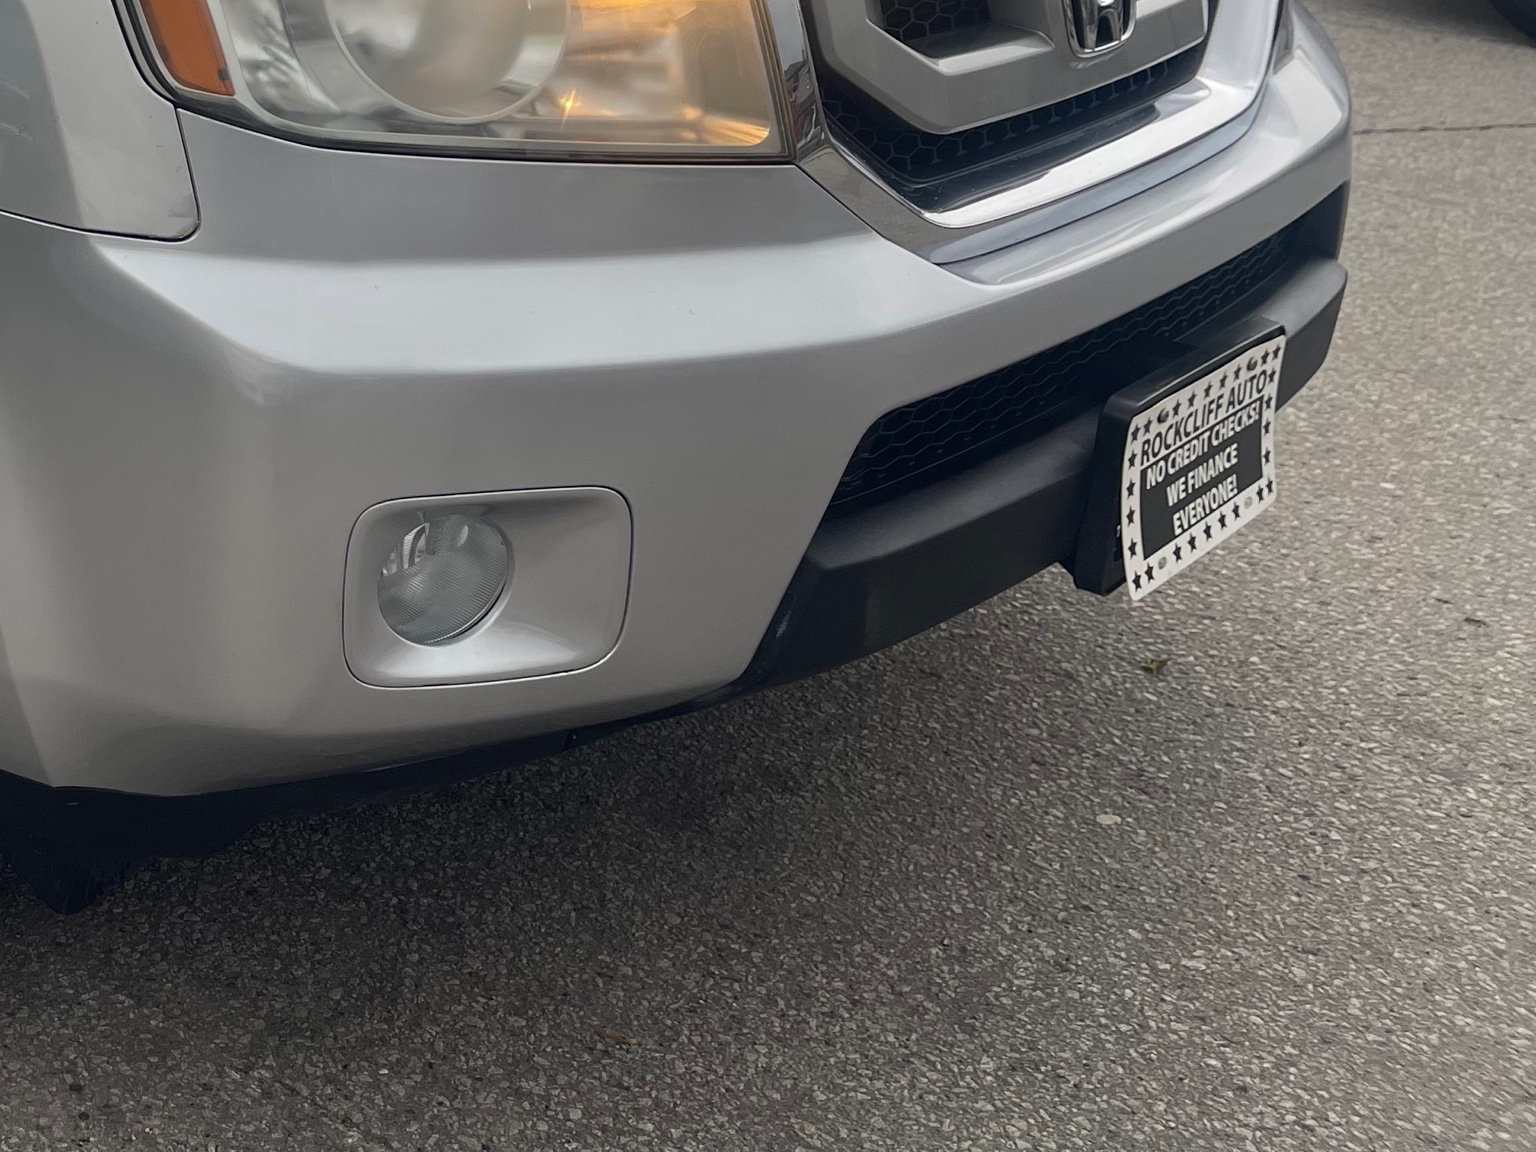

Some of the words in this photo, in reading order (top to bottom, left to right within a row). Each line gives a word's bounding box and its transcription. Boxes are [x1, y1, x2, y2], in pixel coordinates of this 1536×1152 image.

[1140, 392, 1224, 468] ROCKCLIFF
[1225, 368, 1268, 414] AUTO
[1146, 459, 1165, 490] NO
[1167, 430, 1211, 475] CREDIT
[1211, 399, 1261, 447] CHECKS!
[1166, 476, 1187, 507] WE
[1187, 442, 1239, 494] FINANCE
[1172, 473, 1239, 537] EVERYONE!
